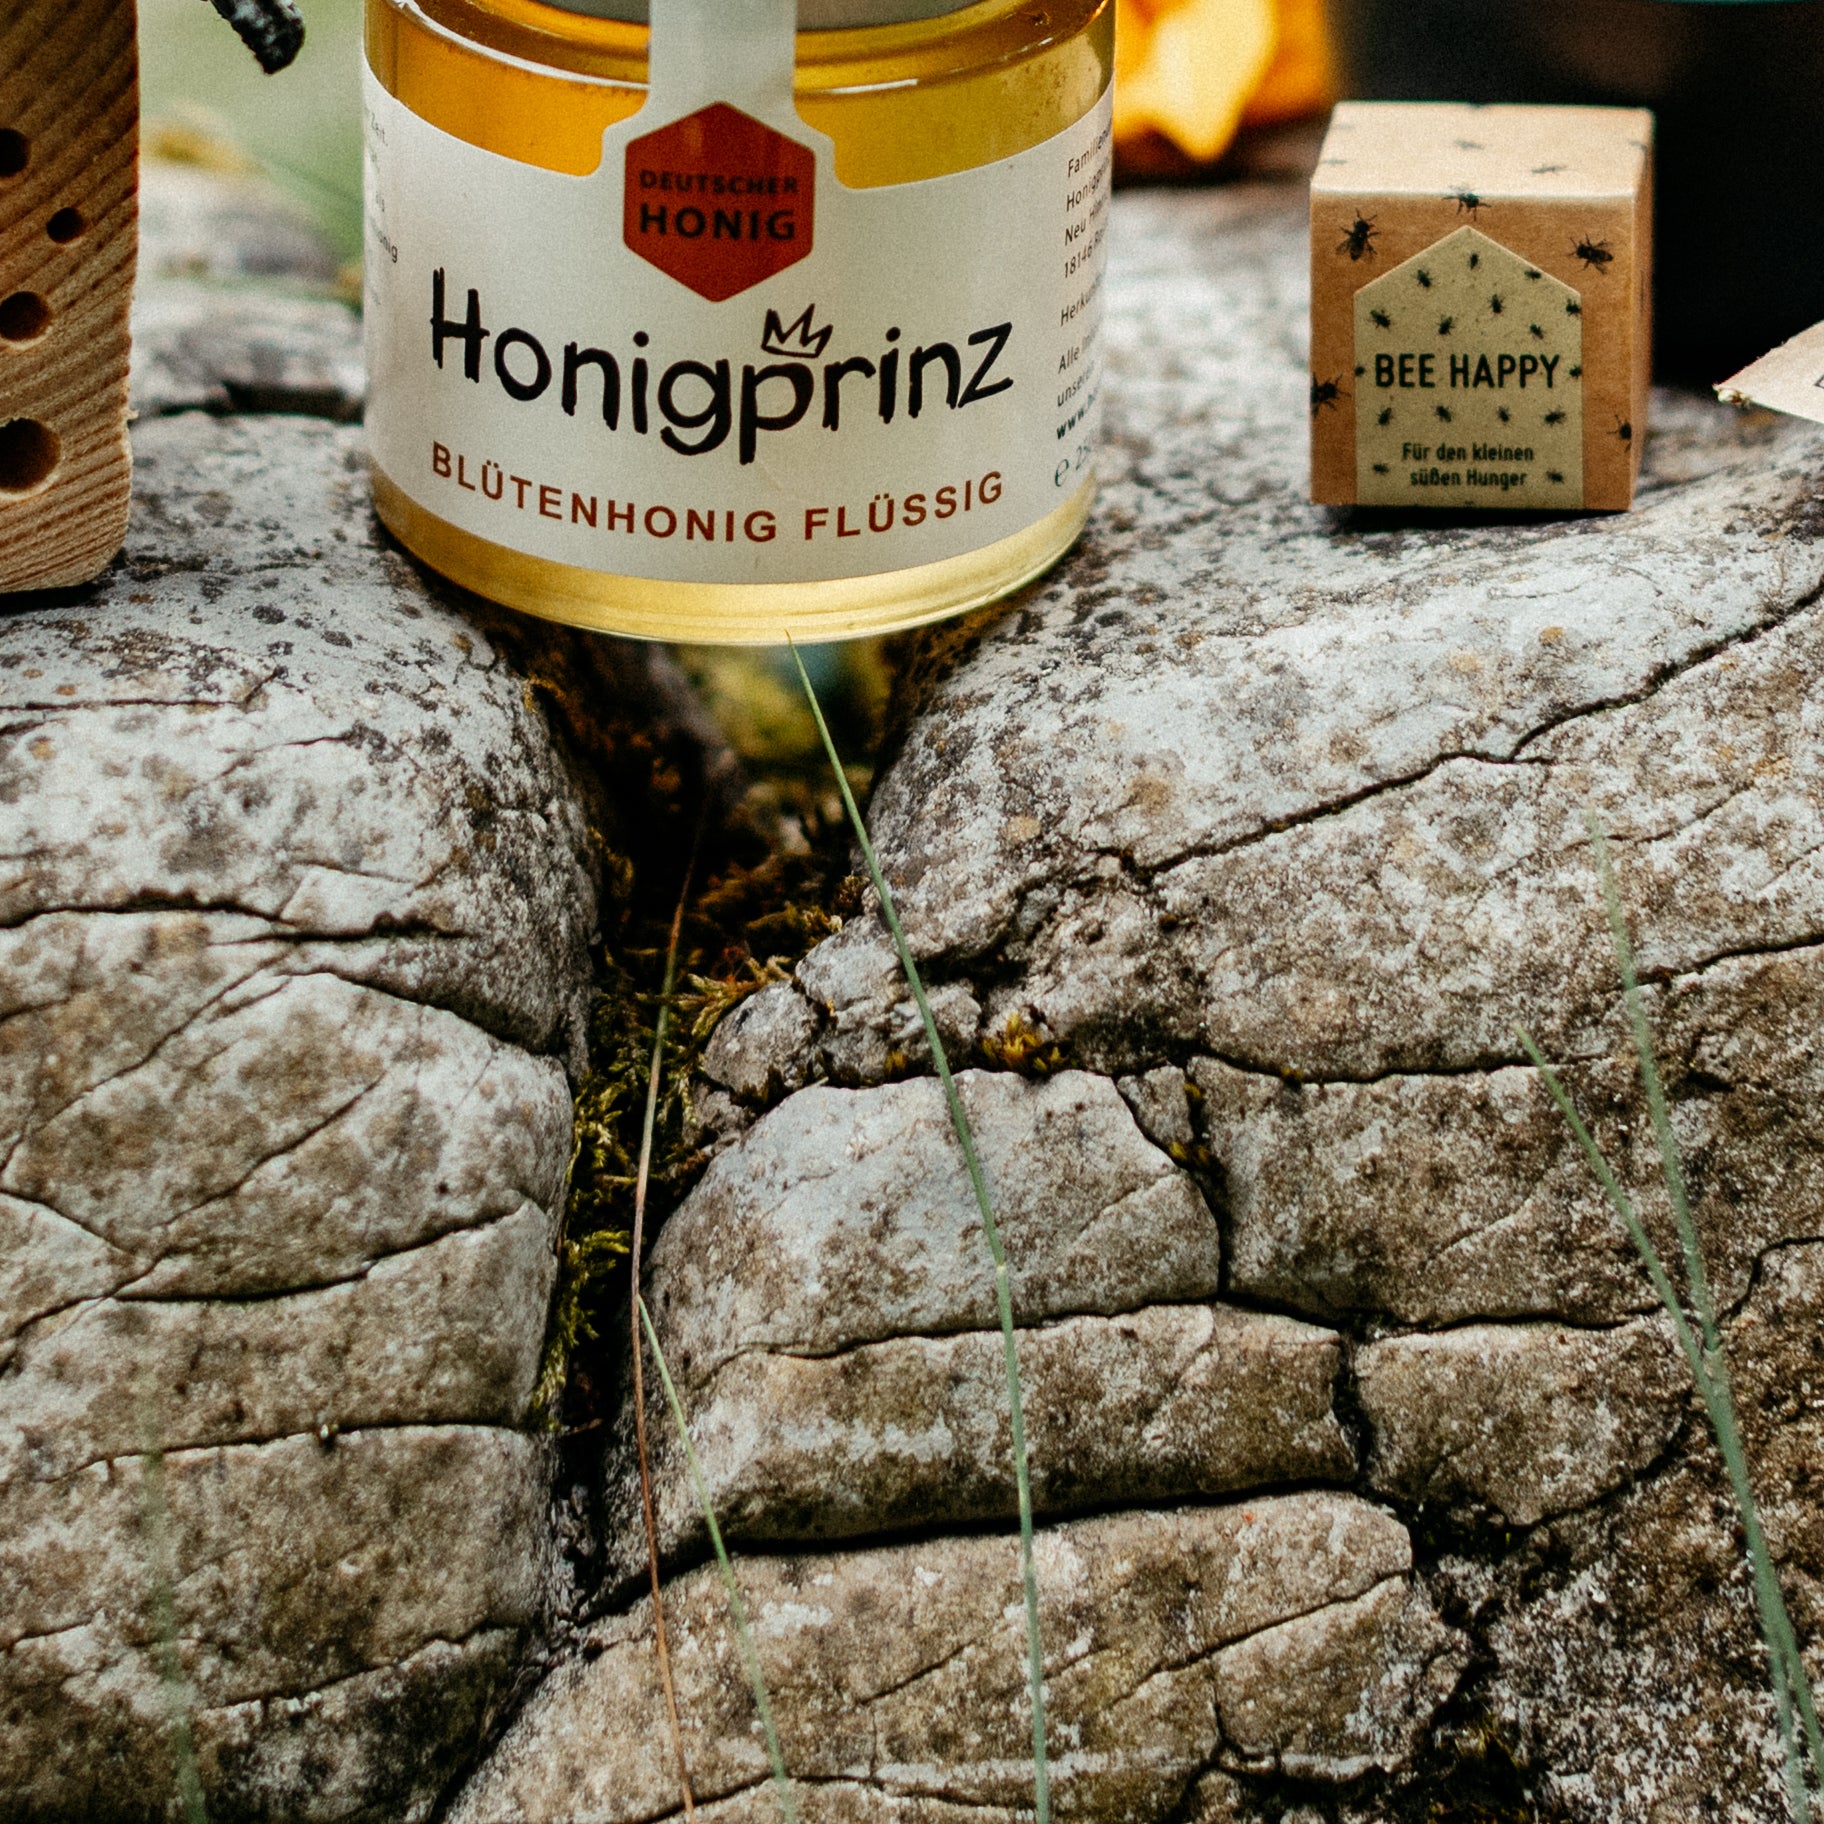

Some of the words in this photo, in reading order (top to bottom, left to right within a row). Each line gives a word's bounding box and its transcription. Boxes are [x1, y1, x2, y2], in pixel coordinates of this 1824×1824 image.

[639, 168, 800, 195] DEUTSCHER
[639, 202, 796, 241] HONIG
[1063, 238, 1094, 279] 18146
[430, 266, 1015, 465] Honigprinz
[1057, 344, 1081, 375] Alle
[1375, 353, 1436, 389] BEE
[1449, 353, 1561, 389] HAPPY
[1402, 441, 1430, 462] Für
[1435, 442, 1467, 462] den
[1472, 442, 1535, 462] kleinen
[432, 440, 777, 543] BLÜTENHONIG
[804, 470, 1003, 541] FLÜSSIG
[1409, 466, 1462, 487] süßen
[1466, 468, 1528, 492] Hunger
